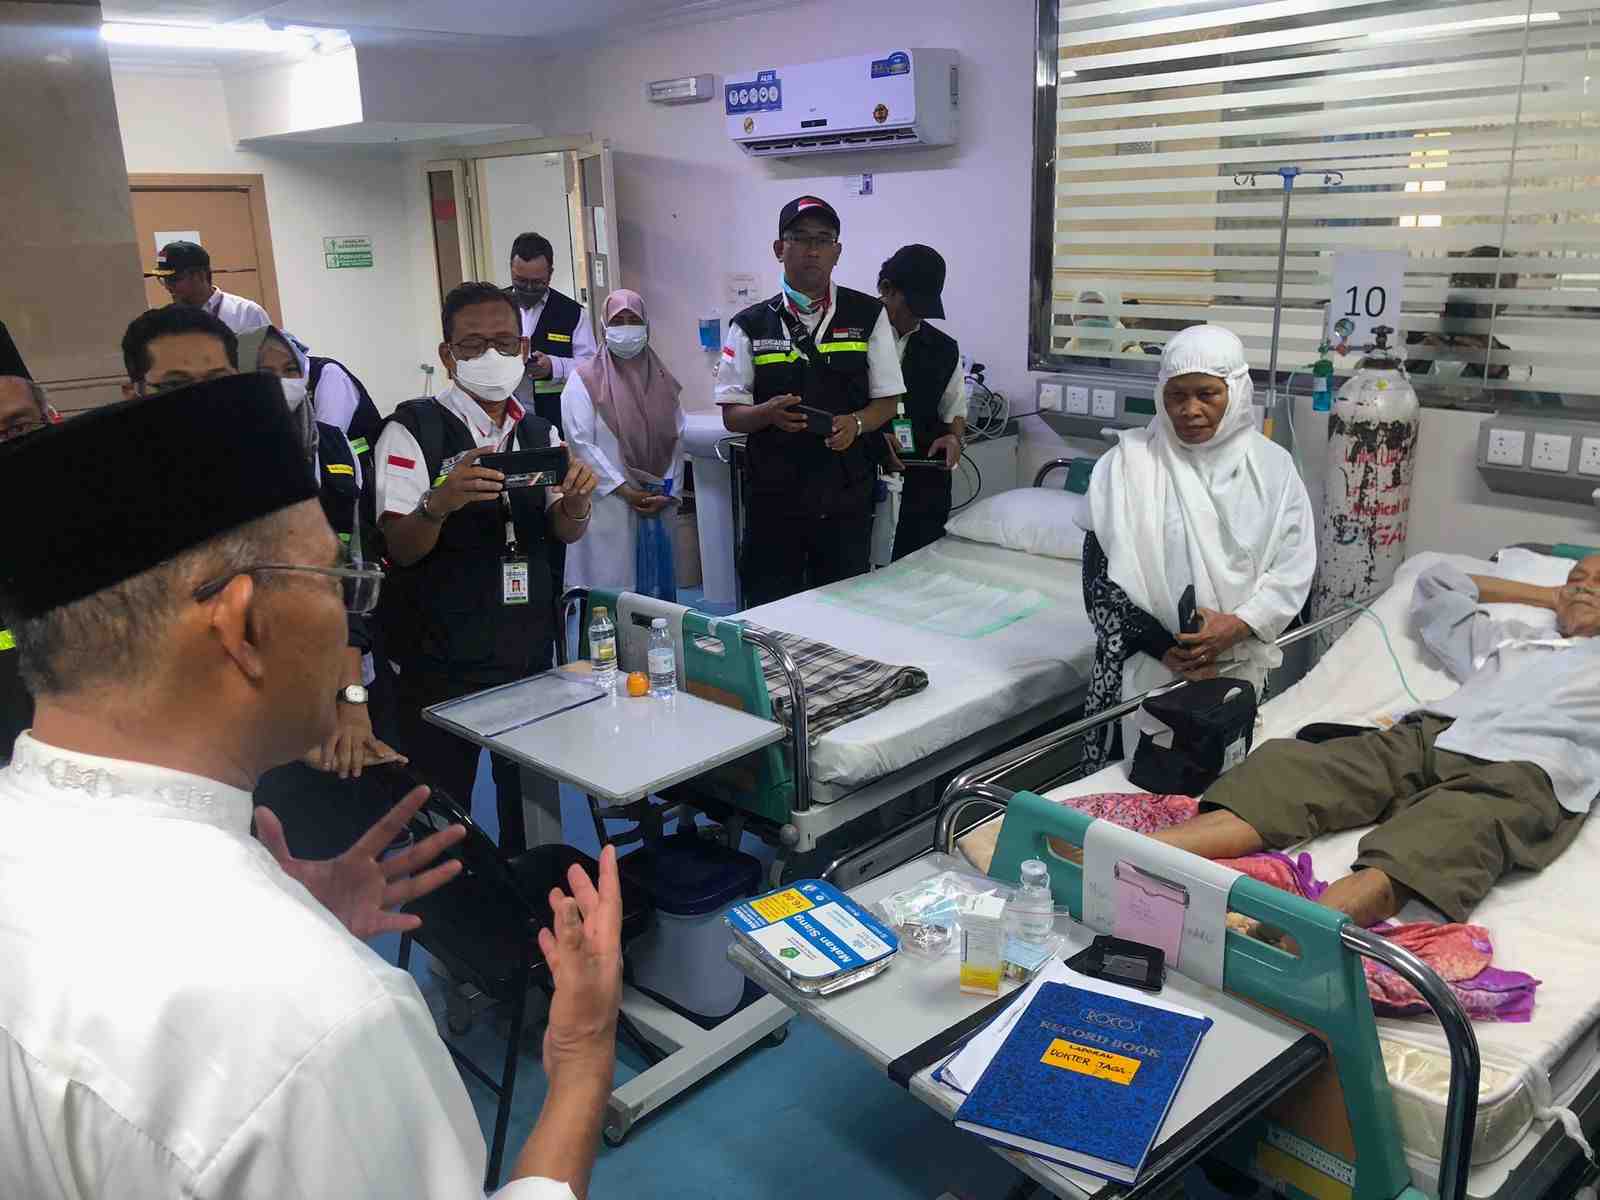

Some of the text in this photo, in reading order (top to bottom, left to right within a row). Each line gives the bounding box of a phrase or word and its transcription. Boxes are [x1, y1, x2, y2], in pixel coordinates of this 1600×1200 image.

[1344, 285, 1386, 318] 10
[793, 914, 822, 939] Siang
[820, 935, 852, 963] Makan
[1040, 1021, 1160, 1058] RECORD BOOK
[1050, 1049, 1091, 1067] DOKTER
